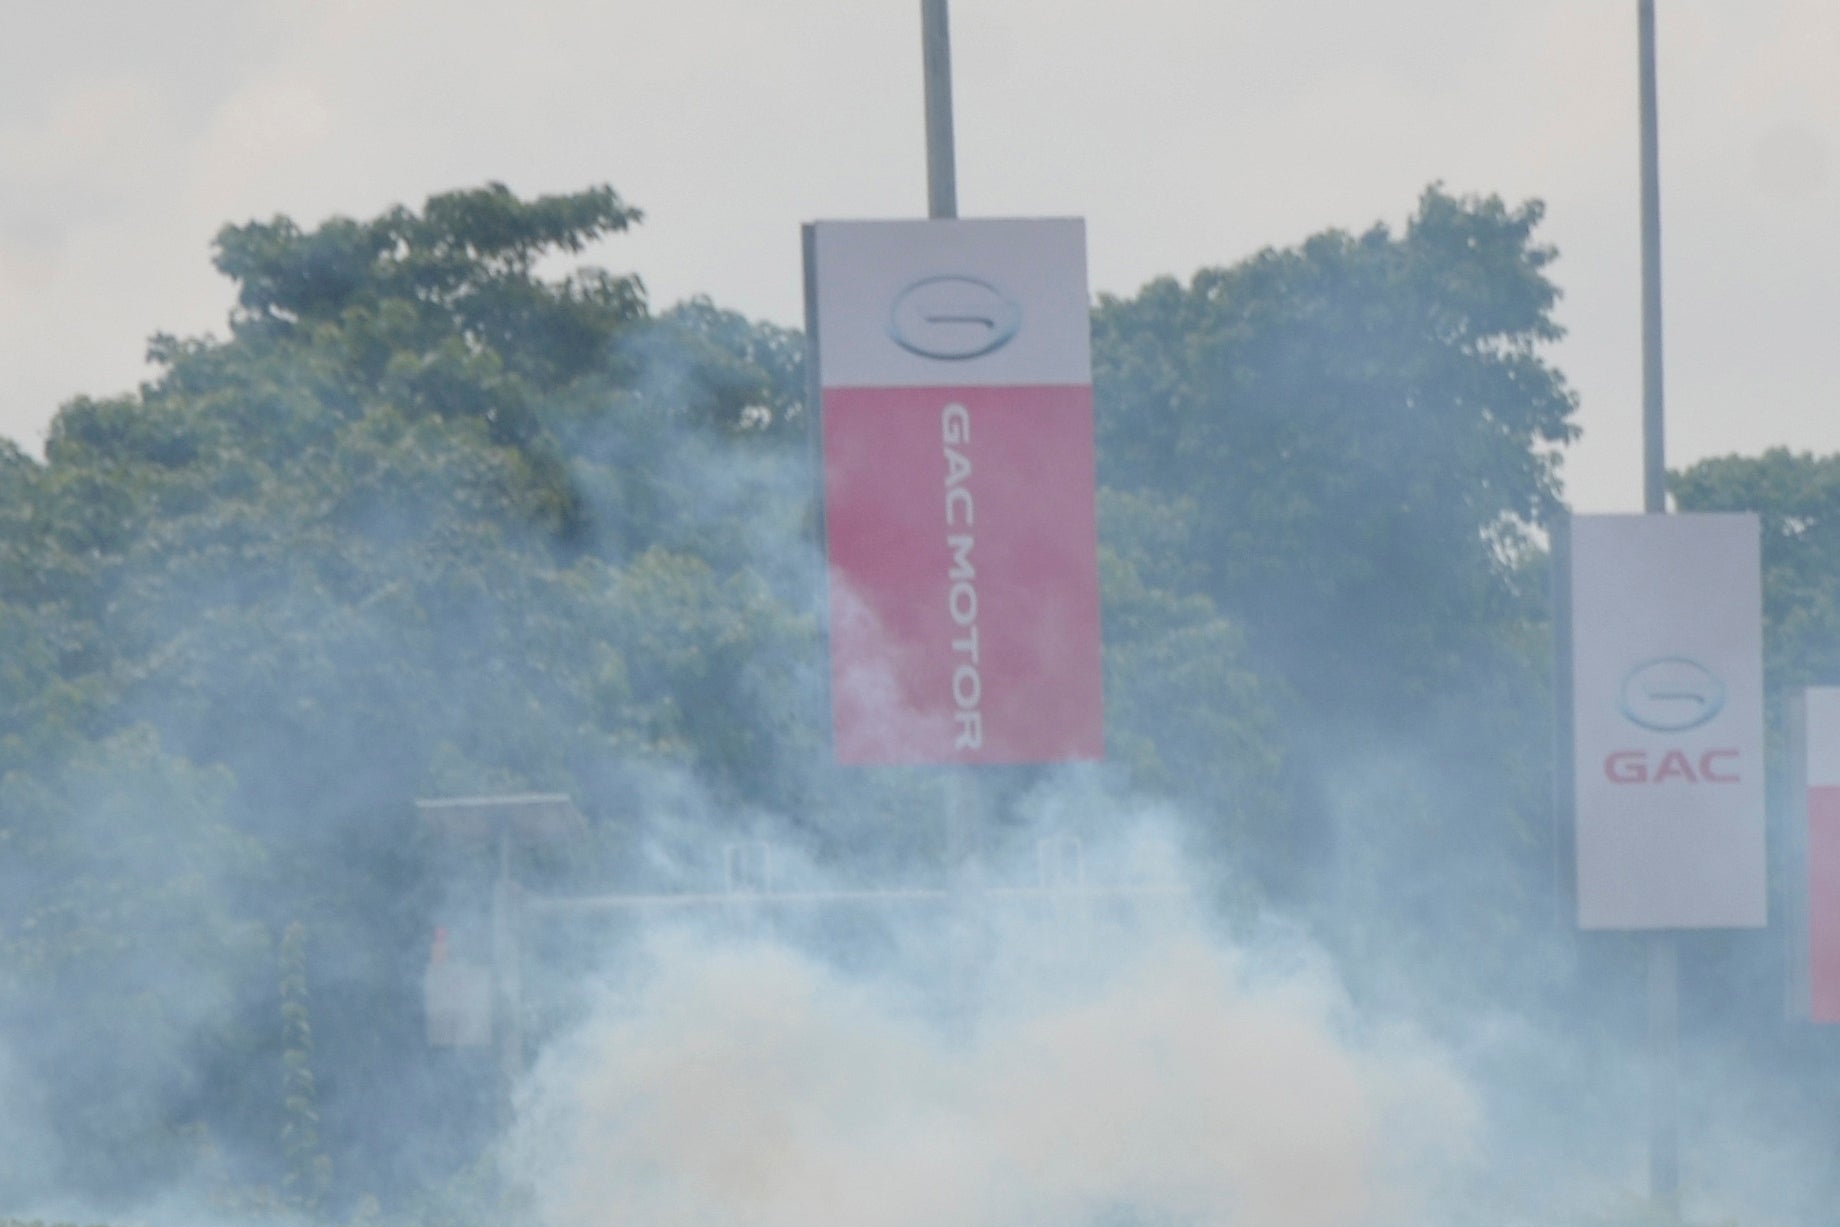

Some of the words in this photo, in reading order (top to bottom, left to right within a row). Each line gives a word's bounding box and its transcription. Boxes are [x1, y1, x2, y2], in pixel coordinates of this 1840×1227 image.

[940, 402, 974, 525] GAC
[946, 535, 983, 751] MOTOR
[1604, 748, 1741, 784] GAC
